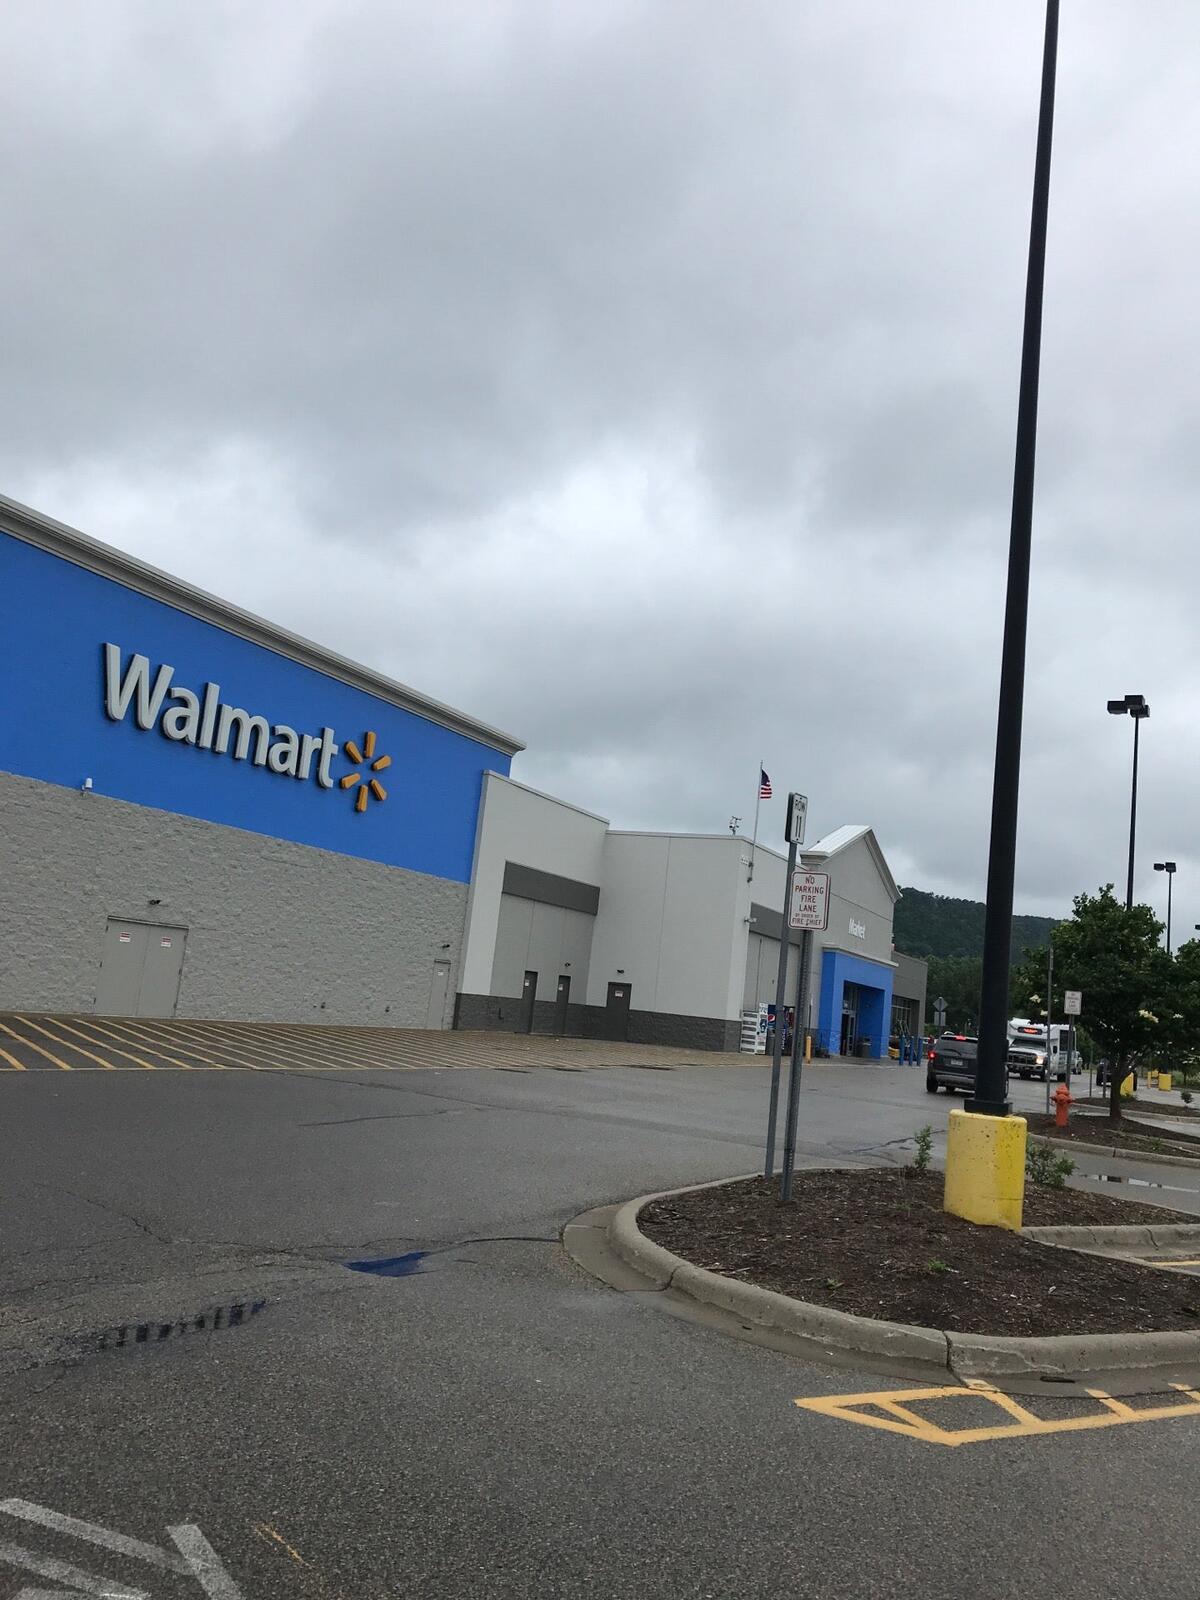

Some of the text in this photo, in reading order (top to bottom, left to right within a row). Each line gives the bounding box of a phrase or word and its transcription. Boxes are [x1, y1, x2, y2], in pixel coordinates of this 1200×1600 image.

[102, 642, 338, 789] Walmart
[805, 876, 815, 885] NO
[794, 885, 825, 895] PARKING
[801, 894, 817, 904] FIRE
[799, 904, 817, 913] LANE
[792, 917, 822, 926] FIRE CHIEF
